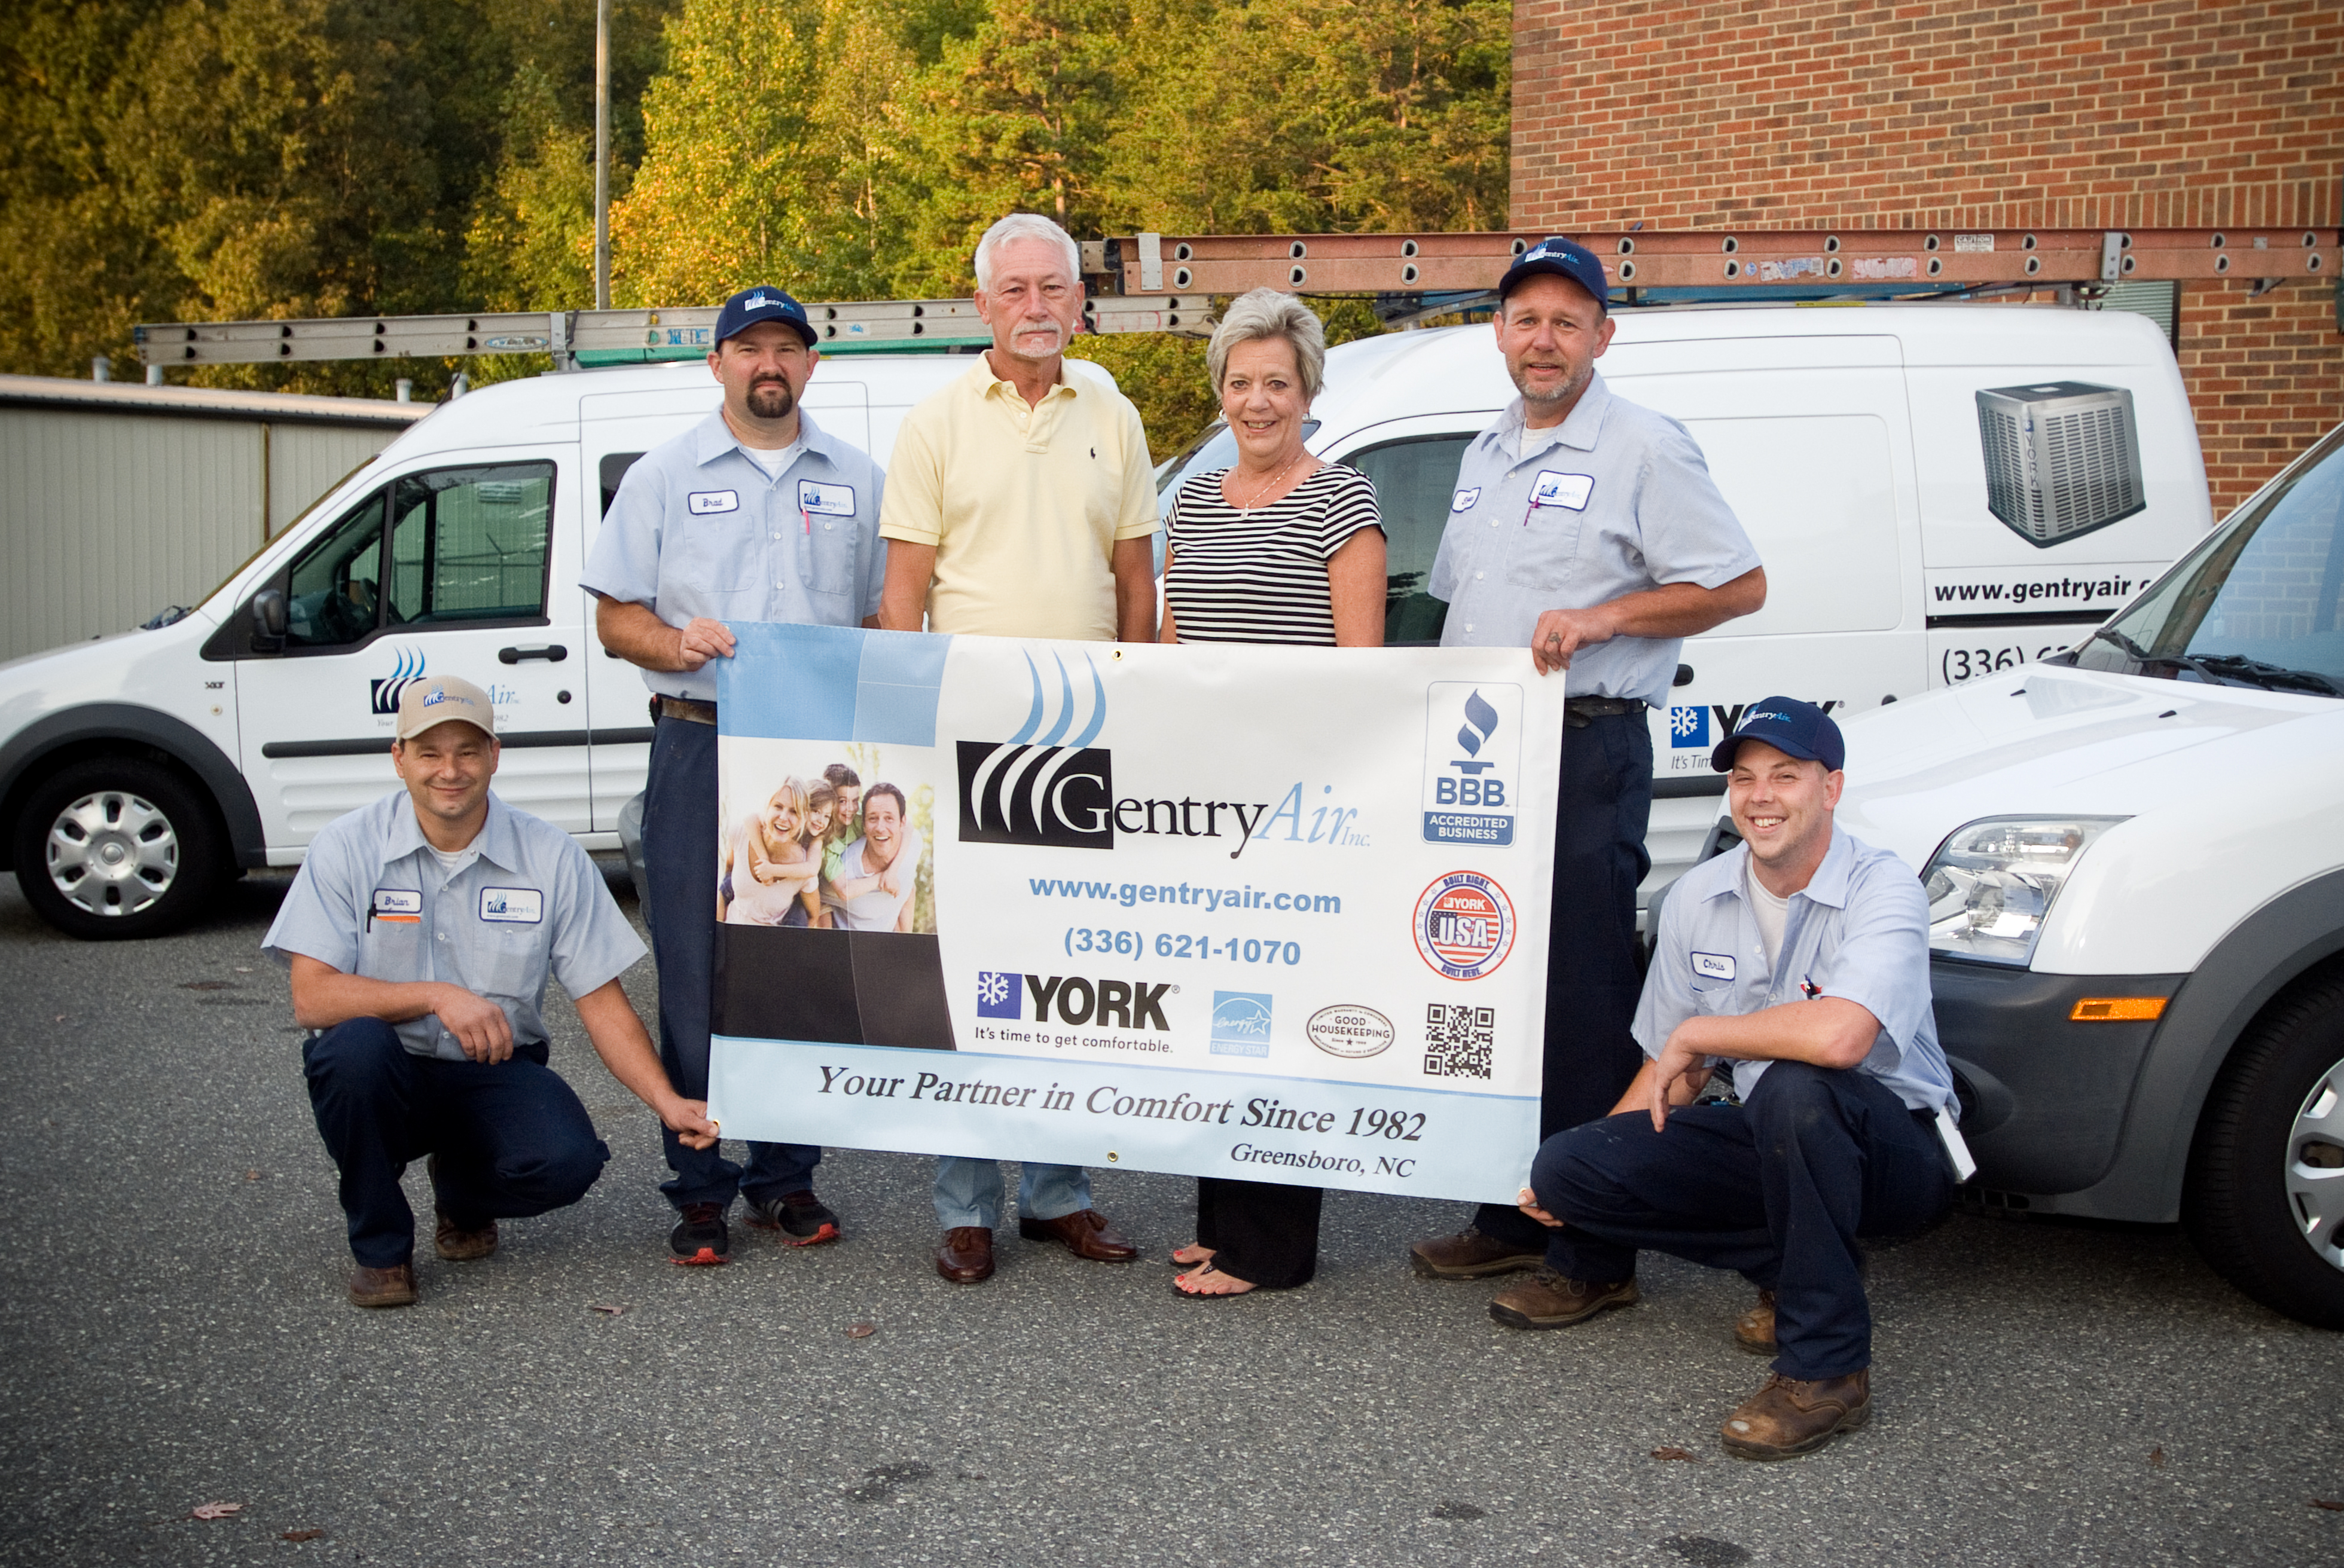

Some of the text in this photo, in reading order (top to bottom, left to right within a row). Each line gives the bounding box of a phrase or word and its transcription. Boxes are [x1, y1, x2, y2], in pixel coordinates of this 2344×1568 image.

[2026, 435, 2039, 487] YORK
[703, 499, 724, 507] Brad
[1935, 574, 2152, 603] www.gentryair
[1671, 754, 1713, 769] It's Tim
[1436, 777, 1506, 807] BBB
[1429, 814, 1508, 829] ACCREDITED
[1438, 826, 1498, 840] BUSINESS
[1443, 875, 1464, 887] BUILT
[384, 895, 410, 906] Brian
[1029, 878, 1341, 913] www.gentryair.com
[1454, 897, 1487, 910] YORK
[1438, 916, 1489, 948] USA
[1064, 927, 1301, 965] (336) 621-1070
[1441, 964, 1461, 977] BUILT
[1024, 974, 1171, 1031] YORK
[1335, 1016, 1366, 1026] GOOD
[1312, 1024, 1390, 1039] HOUSEKEEPING
[975, 1026, 1174, 1053] It's time to get comfortable.
[1211, 1042, 1268, 1056] ENERGY STAR
[817, 1066, 1427, 1141] Your Partner in Comfort Since 1982
[1231, 1144, 1416, 1178] Greensboro, NC
